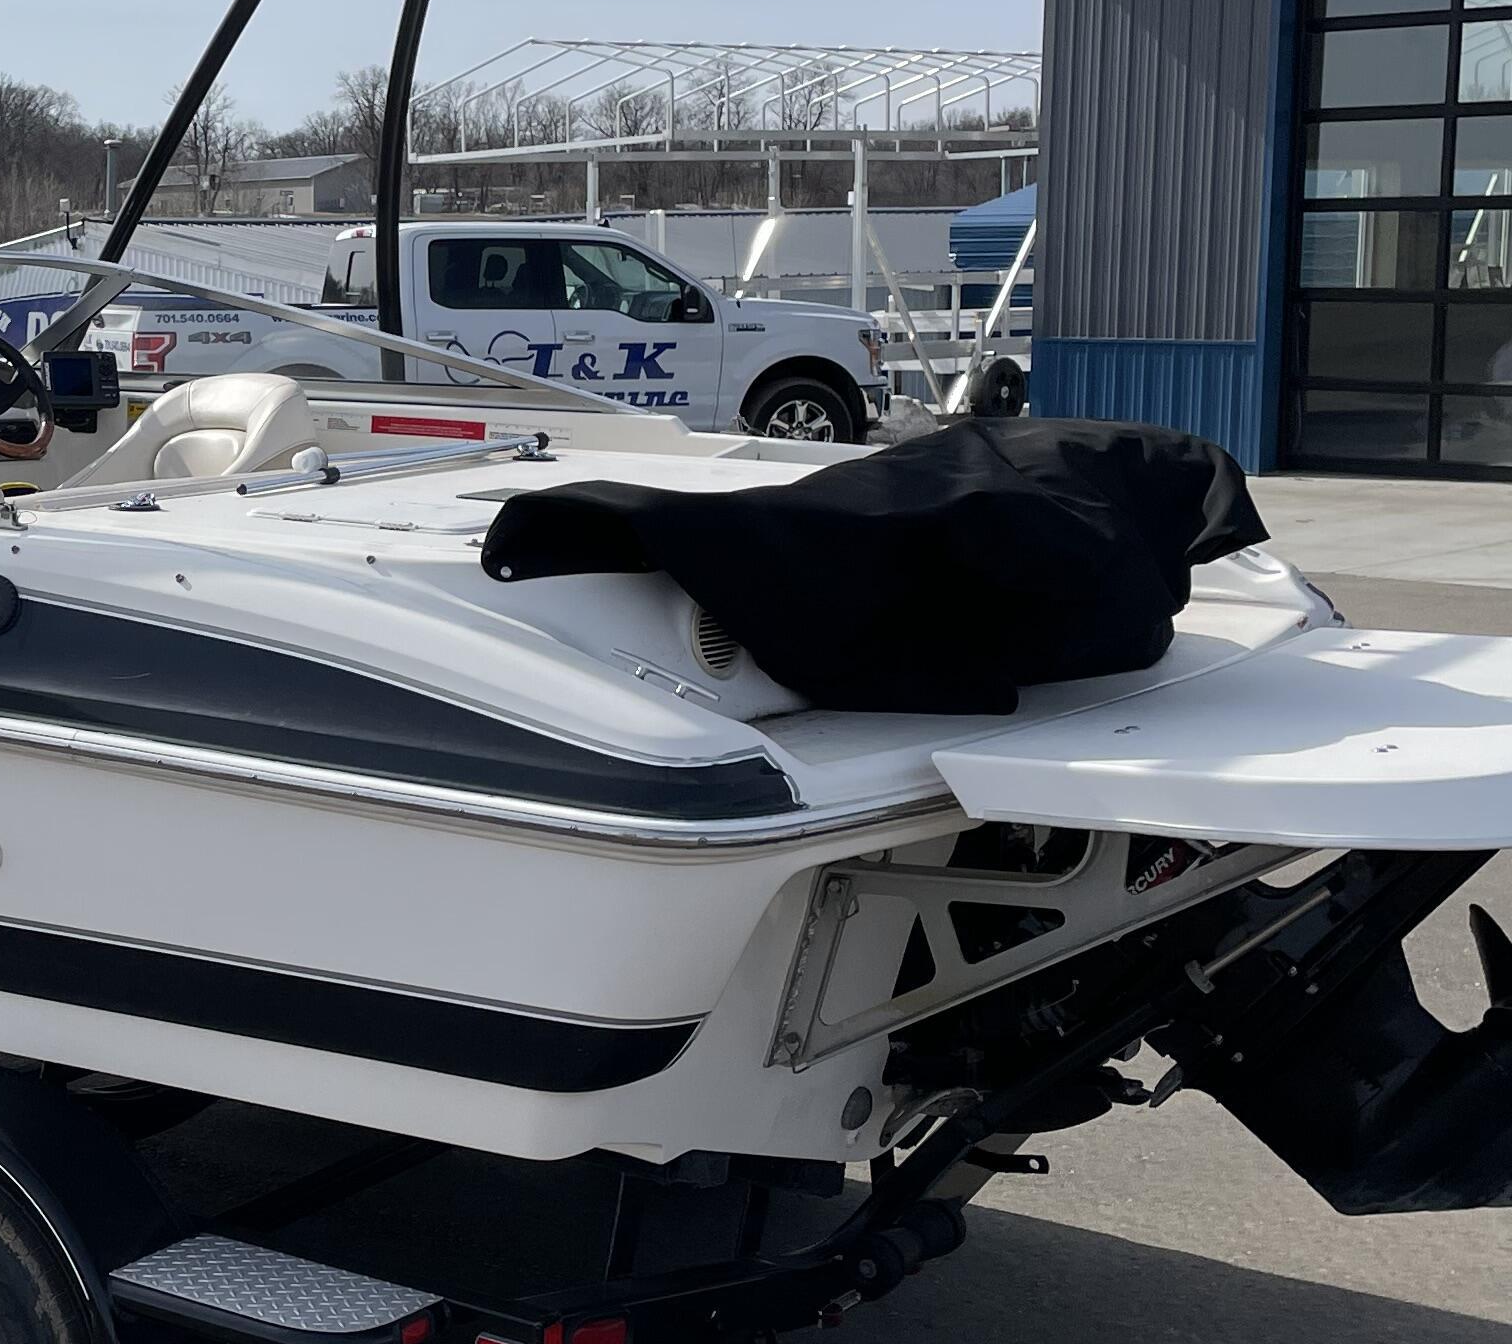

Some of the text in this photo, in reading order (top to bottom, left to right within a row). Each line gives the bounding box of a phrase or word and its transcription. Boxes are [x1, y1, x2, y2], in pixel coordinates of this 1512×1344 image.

[154, 313, 240, 324] 701.540.0664
[571, 353, 605, 380] &
[612, 342, 677, 380] K
